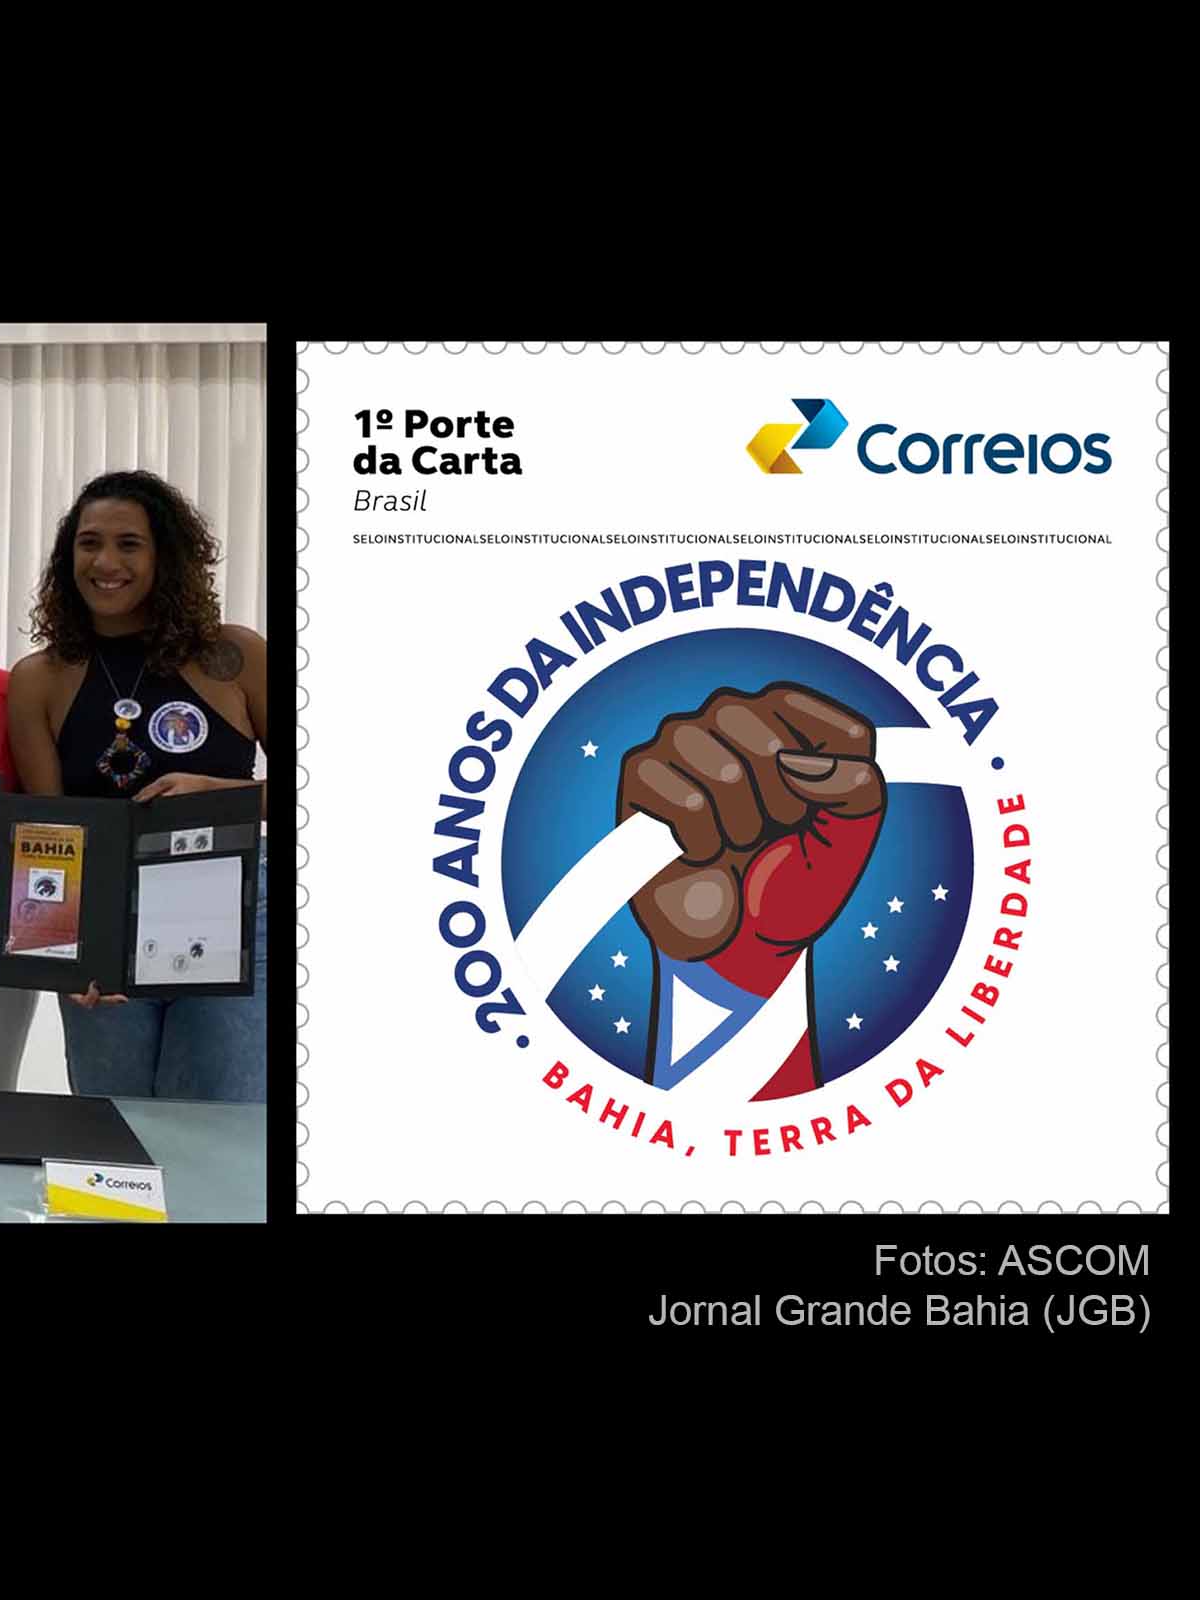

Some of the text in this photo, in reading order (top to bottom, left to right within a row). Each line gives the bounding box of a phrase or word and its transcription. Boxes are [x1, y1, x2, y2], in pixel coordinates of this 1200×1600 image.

[355, 409, 514, 439] 1º Porte
[354, 445, 522, 475] da Carta
[856, 423, 1113, 475] Correios
[353, 489, 428, 512] Brasil
[432, 559, 1000, 1034] 200 ANOS DA INDEPENDÊNCIA
[21, 841, 76, 857] BAHIA
[543, 794, 1032, 1157] BAHIA, TERRA DA LIBERDADE
[105, 1177, 152, 1191] Correios
